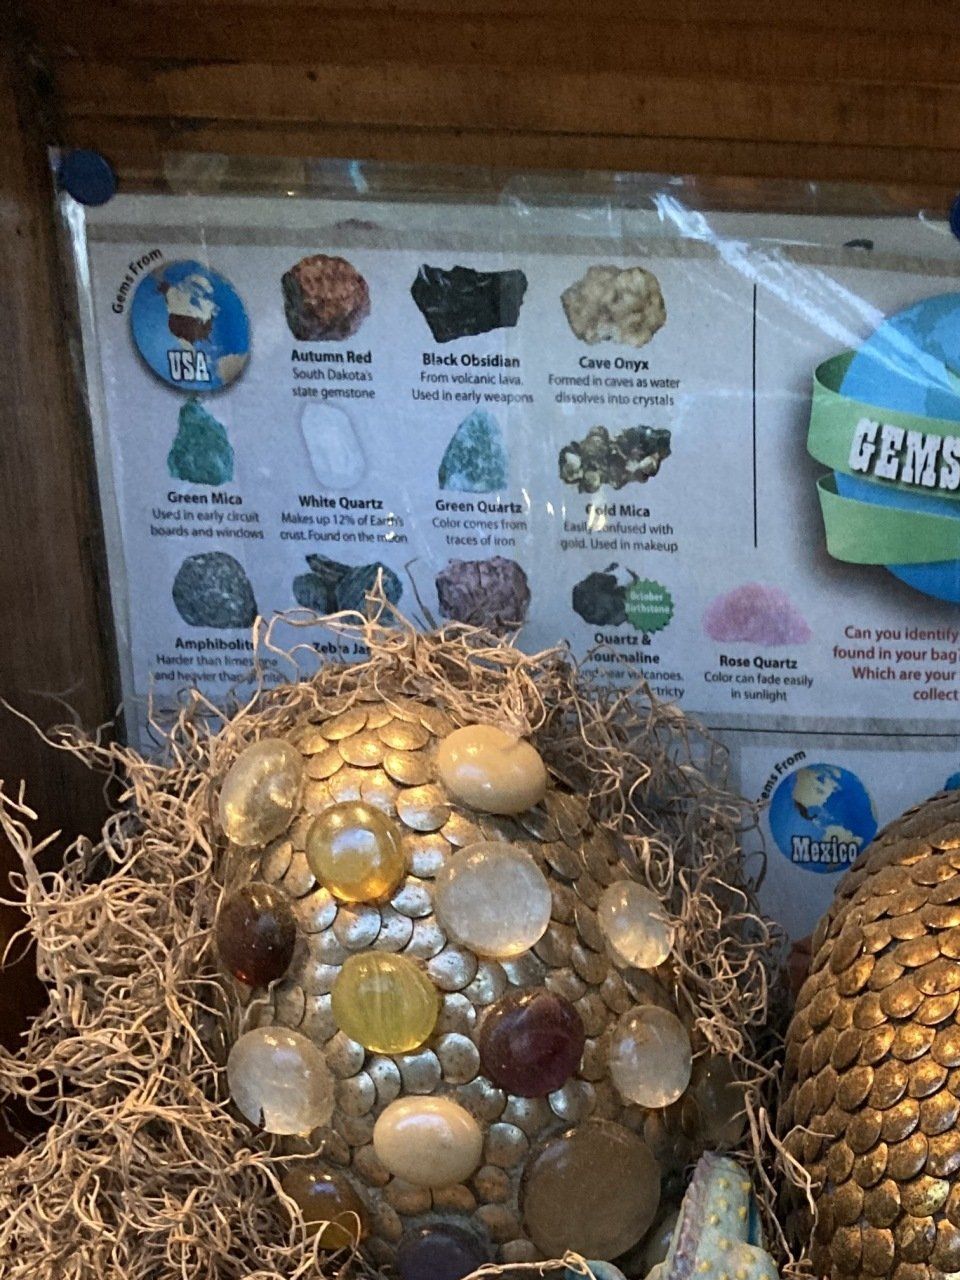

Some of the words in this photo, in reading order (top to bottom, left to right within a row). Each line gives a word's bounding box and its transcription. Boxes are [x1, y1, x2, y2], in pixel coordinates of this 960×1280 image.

[111, 274, 134, 313] Gems
[128, 249, 162, 275] From
[292, 350, 343, 363] Autumn
[347, 351, 371, 363] Red
[423, 354, 457, 366] Black
[461, 354, 520, 367] Obsidian
[168, 351, 209, 381] USA
[579, 356, 610, 369] Cave
[615, 359, 648, 372] Onyx
[293, 368, 323, 380] South
[327, 369, 372, 382] Dakota's
[421, 372, 449, 383] From
[452, 372, 495, 385] volcanic
[549, 374, 590, 386] Formed
[593, 375, 602, 386] in
[605, 378, 633, 387] caves
[650, 379, 680, 388] water
[292, 387, 318, 397] state
[321, 388, 375, 399] gemstone
[412, 390, 439, 400] Used
[443, 390, 452, 400] in
[455, 391, 481, 404] early
[484, 394, 534, 404] weapons
[556, 392, 604, 403] dissolves
[608, 394, 630, 404] into
[632, 395, 674, 406] crystals
[168, 492, 207, 503] Green
[212, 493, 242, 505] Mica
[299, 495, 336, 508] White
[339, 497, 383, 509] Quartz
[436, 500, 474, 512] Green
[477, 501, 522, 514] Quartz
[620, 505, 650, 517] Mica
[152, 508, 180, 520] Used
[184, 510, 193, 520] in
[197, 511, 223, 523] early
[227, 511, 259, 522] circuit
[432, 518, 460, 528] Color
[464, 520, 498, 529] comes
[501, 519, 527, 530] from
[151, 525, 188, 537] boards
[191, 527, 213, 537] and
[216, 528, 264, 539] windows
[446, 535, 477, 545] traces
[481, 535, 491, 545] of
[494, 536, 515, 546] iron
[591, 539, 617, 549] Used
[621, 540, 630, 550] in
[634, 540, 678, 553] makeup
[595, 633, 638, 646] Quartz
[642, 634, 651, 645] &
[844, 626, 871, 639] Can
[876, 630, 900, 642] you
[906, 628, 958, 644] identify
[175, 638, 254, 651] Amphibolit
[834, 646, 874, 659] found
[880, 648, 891, 659] in
[896, 651, 928, 662] your
[720, 655, 750, 667] Rose
[753, 657, 797, 669] Quartz
[704, 672, 732, 682] Color
[735, 675, 752, 683] can
[755, 673, 780, 684] fade
[784, 674, 813, 687] easily
[852, 667, 895, 680] Which
[900, 670, 921, 680] are
[925, 671, 955, 683] your
[731, 689, 741, 699] in
[744, 688, 786, 702] sunlight
[914, 688, 958, 701] collect
[757, 773, 778, 803] ems
[774, 751, 806, 774] From
[792, 836, 857, 863] Mexico
